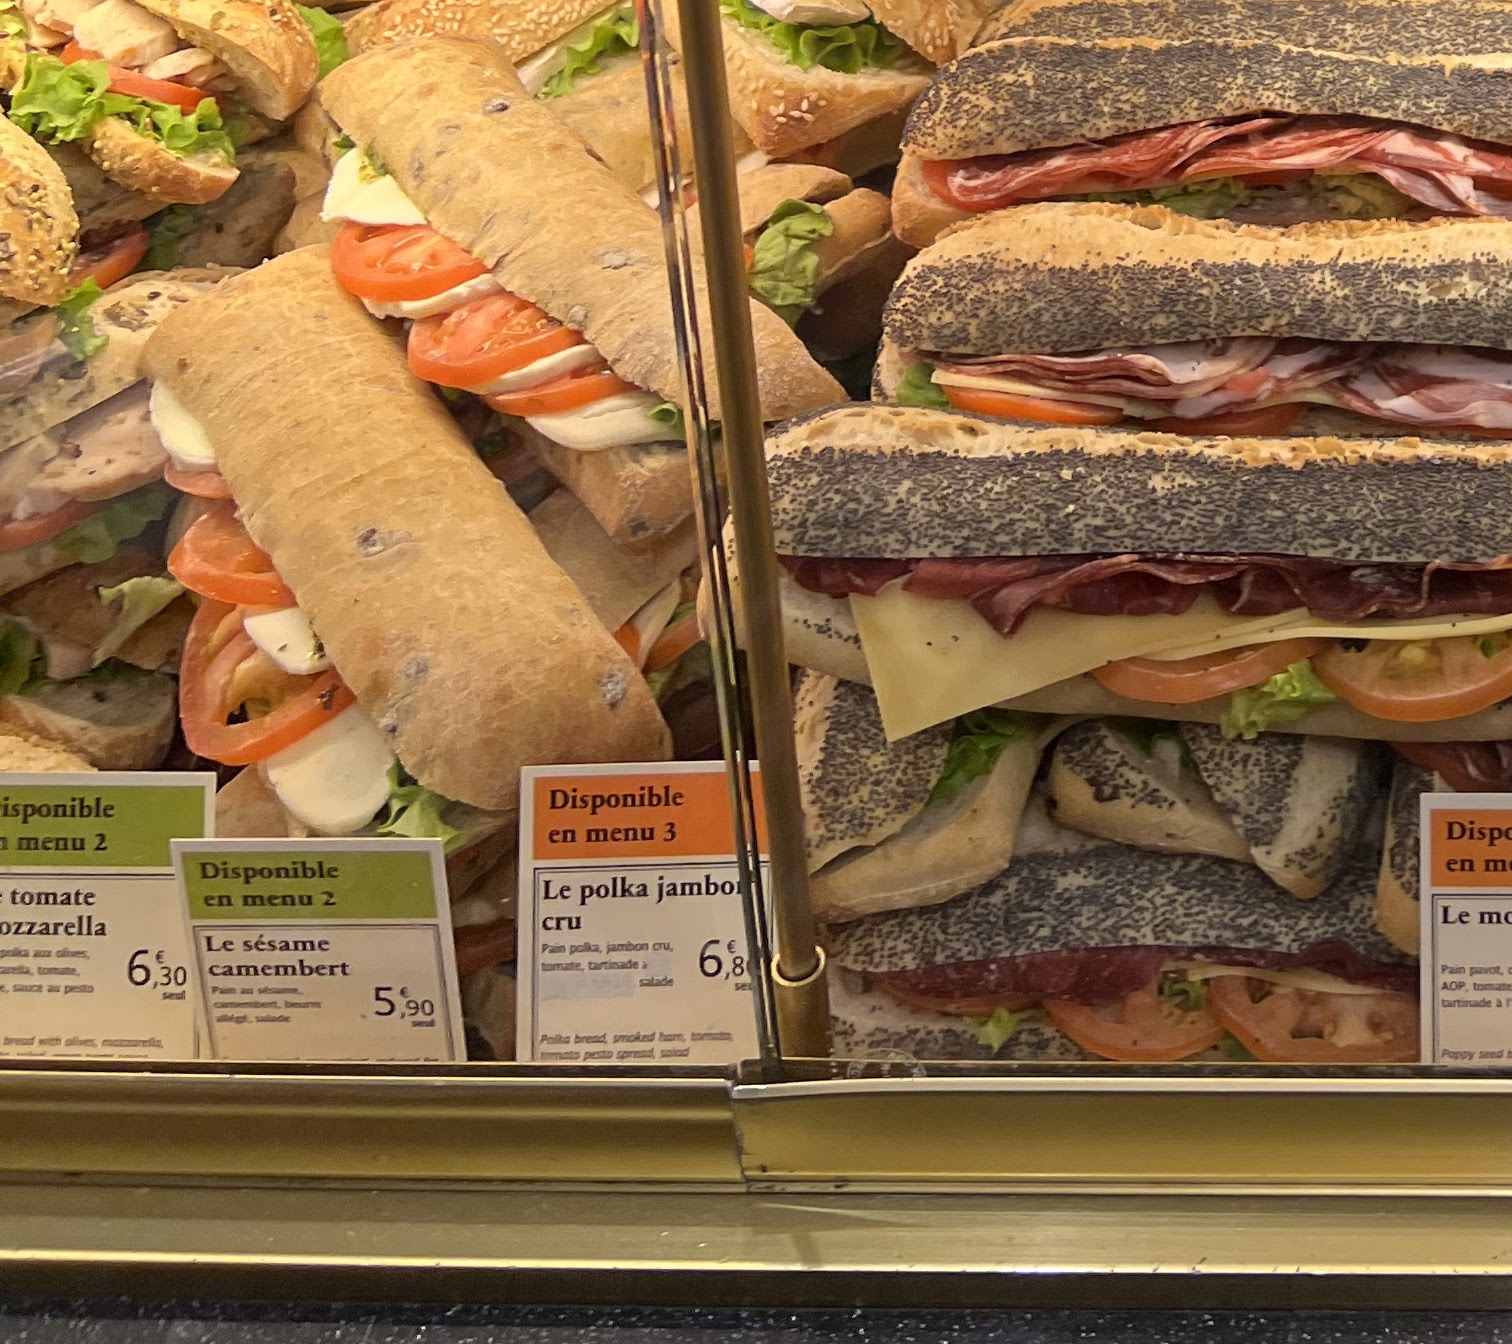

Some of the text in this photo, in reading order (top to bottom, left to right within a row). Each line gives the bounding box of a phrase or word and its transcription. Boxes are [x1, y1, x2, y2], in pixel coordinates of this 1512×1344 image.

[549, 785, 684, 815] Disponible
[0, 796, 114, 824] isponible
[548, 822, 676, 843] en menu 3
[16, 837, 85, 851] menu
[94, 833, 108, 851] 2
[198, 861, 339, 885] Disponible
[1446, 859, 1475, 872] en
[10, 889, 95, 906] tomate
[203, 891, 336, 907] en menu 2
[544, 880, 571, 900] Le
[580, 877, 649, 906] polka
[542, 916, 581, 931] cru
[1442, 906, 1470, 924] Le
[0, 915, 107, 936] ozzarella
[205, 934, 329, 951] Le sésame
[208, 959, 350, 976] camembert
